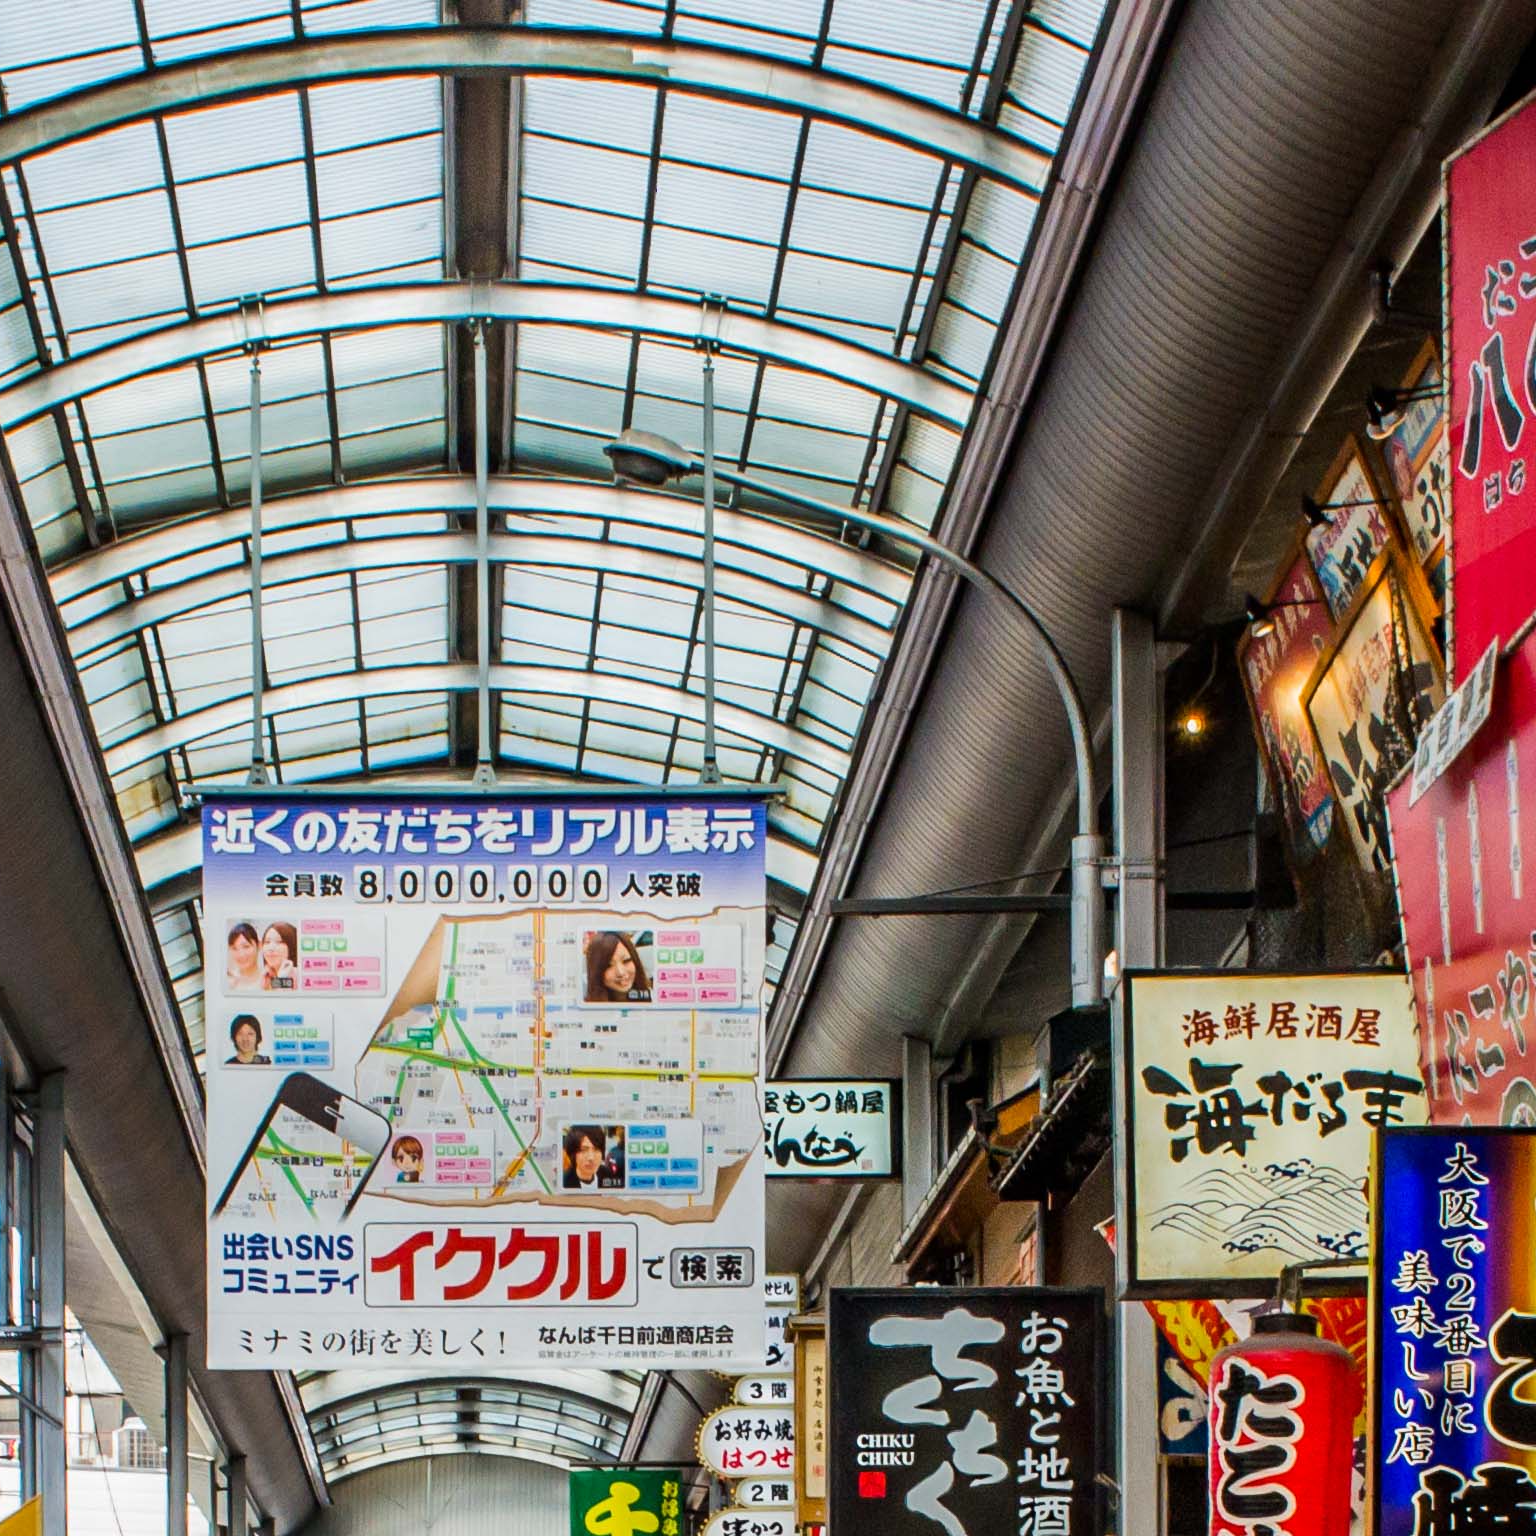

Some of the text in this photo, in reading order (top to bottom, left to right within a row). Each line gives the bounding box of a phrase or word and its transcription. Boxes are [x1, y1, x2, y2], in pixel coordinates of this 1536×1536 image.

[1482, 456, 1528, 517] はち
[210, 807, 757, 857] 近くの友だちをリアル表示
[265, 869, 702, 903] 会員数 8,000,000 人突破
[1182, 1002, 1382, 1047] 海鮮居酒屋
[470, 1067, 506, 1078] 大阪難波
[546, 1066, 572, 1076] なんば
[468, 1106, 495, 1116] なんば
[503, 1098, 529, 1107] なんば
[1140, 1056, 1425, 1163] 海だるま
[514, 1114, 537, 1123] 4丁目
[271, 1156, 313, 1167] 大阪難波
[332, 1166, 362, 1178] なんば
[247, 1191, 277, 1203] なんば
[309, 1187, 339, 1200] なんば
[223, 1233, 355, 1261] 出会いSNS
[370, 1227, 744, 1302] イククル で 検索
[222, 1269, 359, 1296] コミュニティ
[1434, 1143, 1491, 1438] 大阪で2番目に
[236, 1326, 735, 1358] ミナミの街を美しく! なんば千日前通商店会
[1386, 1251, 1440, 1465] 美味しい店
[749, 1381, 787, 1400] 3階
[713, 1420, 795, 1443] お好み焼
[856, 1433, 916, 1451] CHIKU
[722, 1446, 794, 1470] はつせ
[856, 1450, 916, 1467] CHIKU
[750, 1483, 789, 1503] 2階
